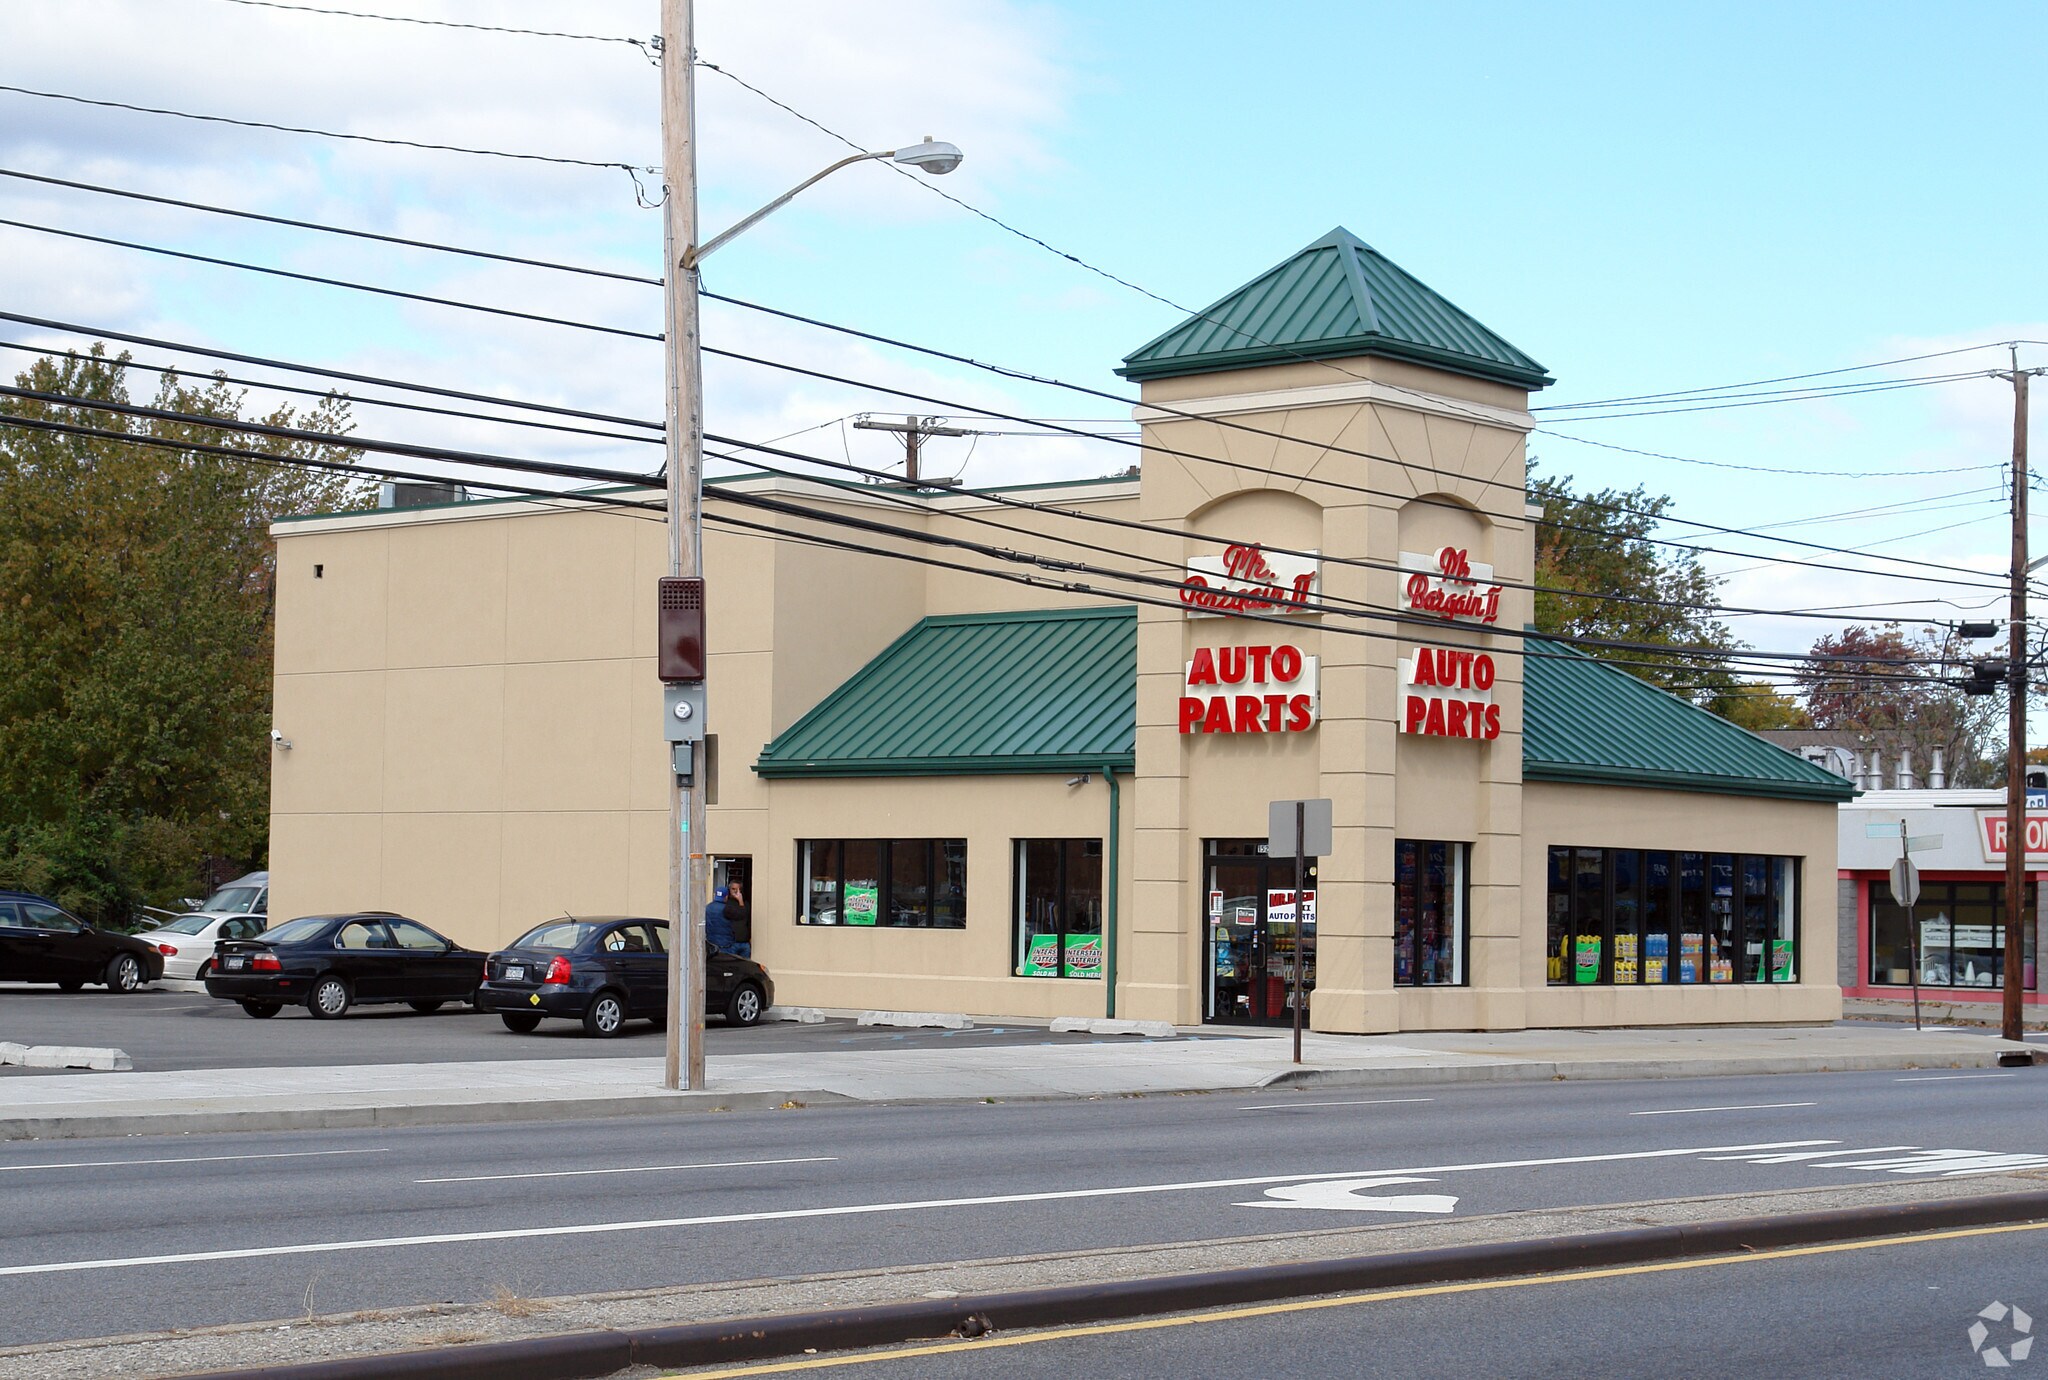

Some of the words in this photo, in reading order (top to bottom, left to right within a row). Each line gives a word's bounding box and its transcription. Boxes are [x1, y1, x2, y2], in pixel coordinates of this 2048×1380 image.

[1223, 542, 1276, 580] Mr.
[1440, 547, 1478, 587] Mr.
[1407, 574, 1485, 621] Bargain
[1187, 645, 1302, 685] AUTO
[1413, 647, 1496, 691] AUTO
[1179, 694, 1312, 735] PARTS
[1406, 695, 1501, 740] PARTS
[1269, 912, 1289, 920] AUTO
[1290, 913, 1316, 921] PRTS
